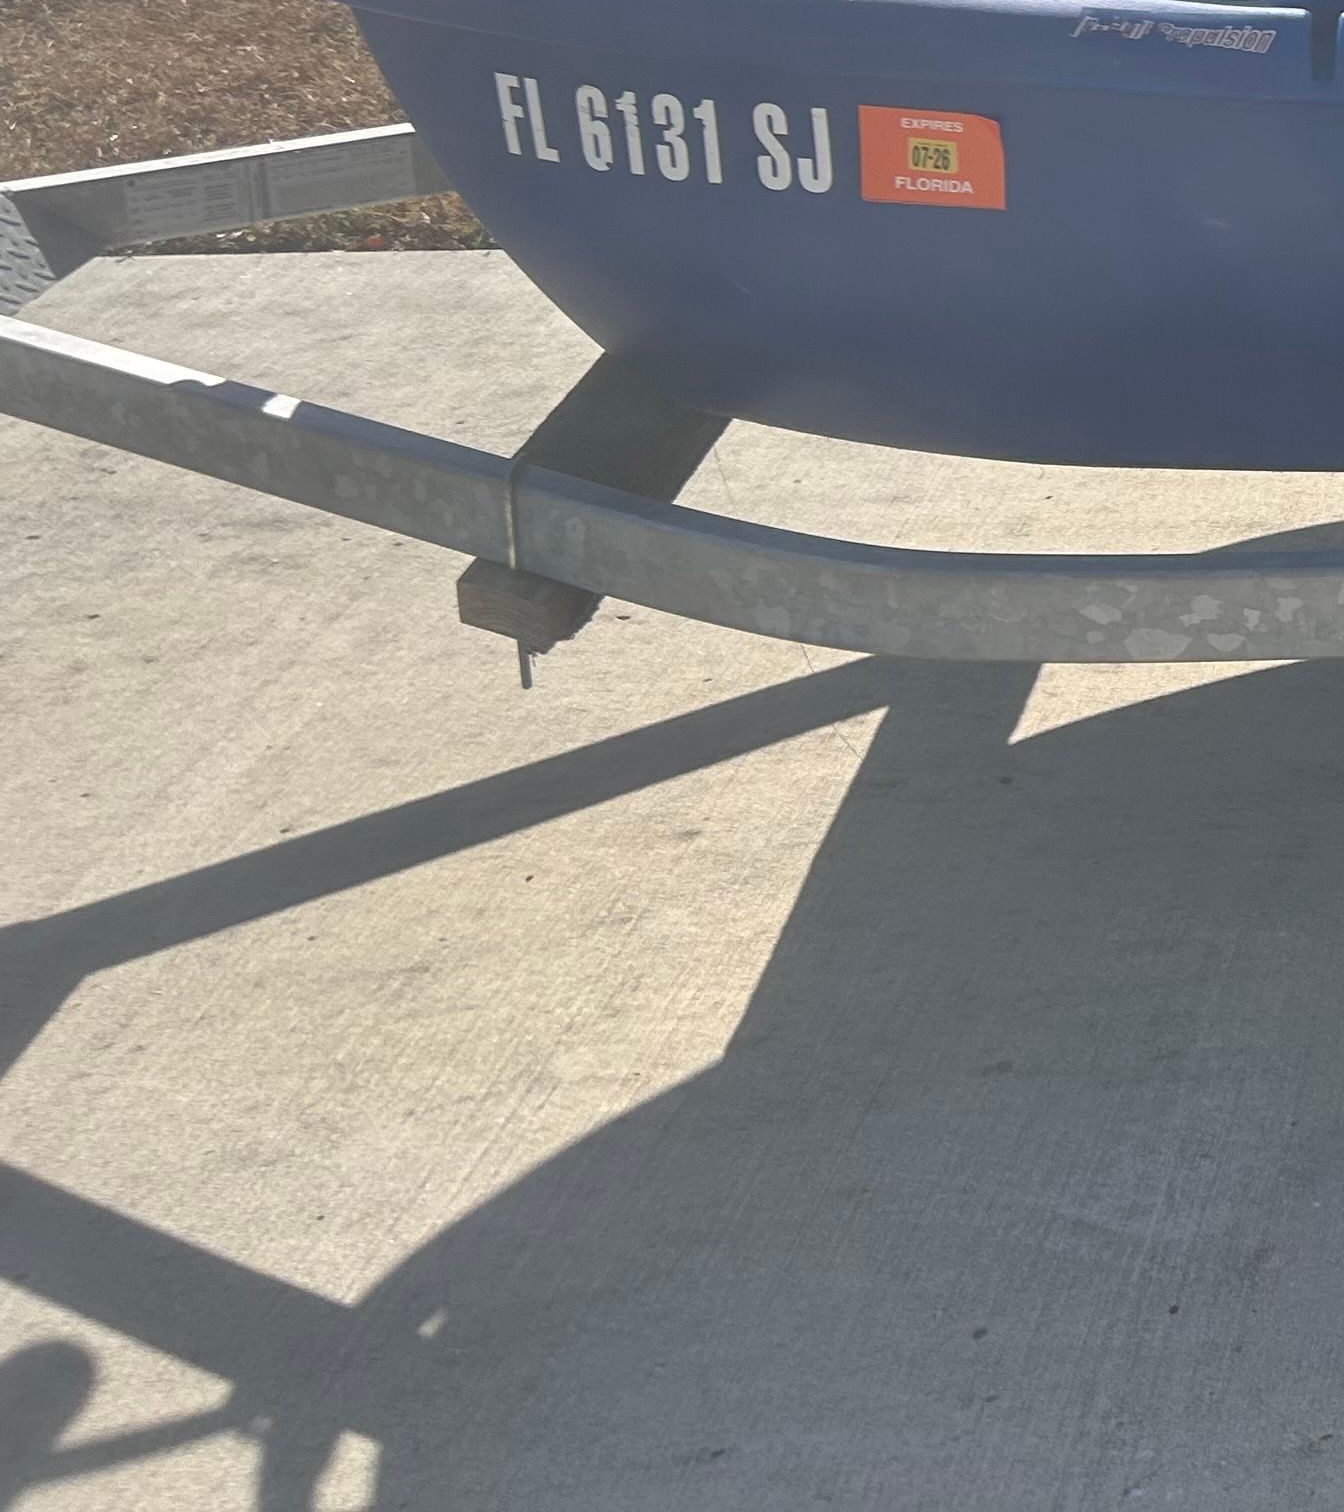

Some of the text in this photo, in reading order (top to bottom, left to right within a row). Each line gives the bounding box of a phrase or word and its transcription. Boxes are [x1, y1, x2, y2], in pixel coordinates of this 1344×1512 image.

[494, 72, 833, 193] FL 6131 SJ
[900, 117, 964, 133] EXPIRES
[911, 144, 951, 170] 07-26
[894, 176, 974, 194] FLORIDA
